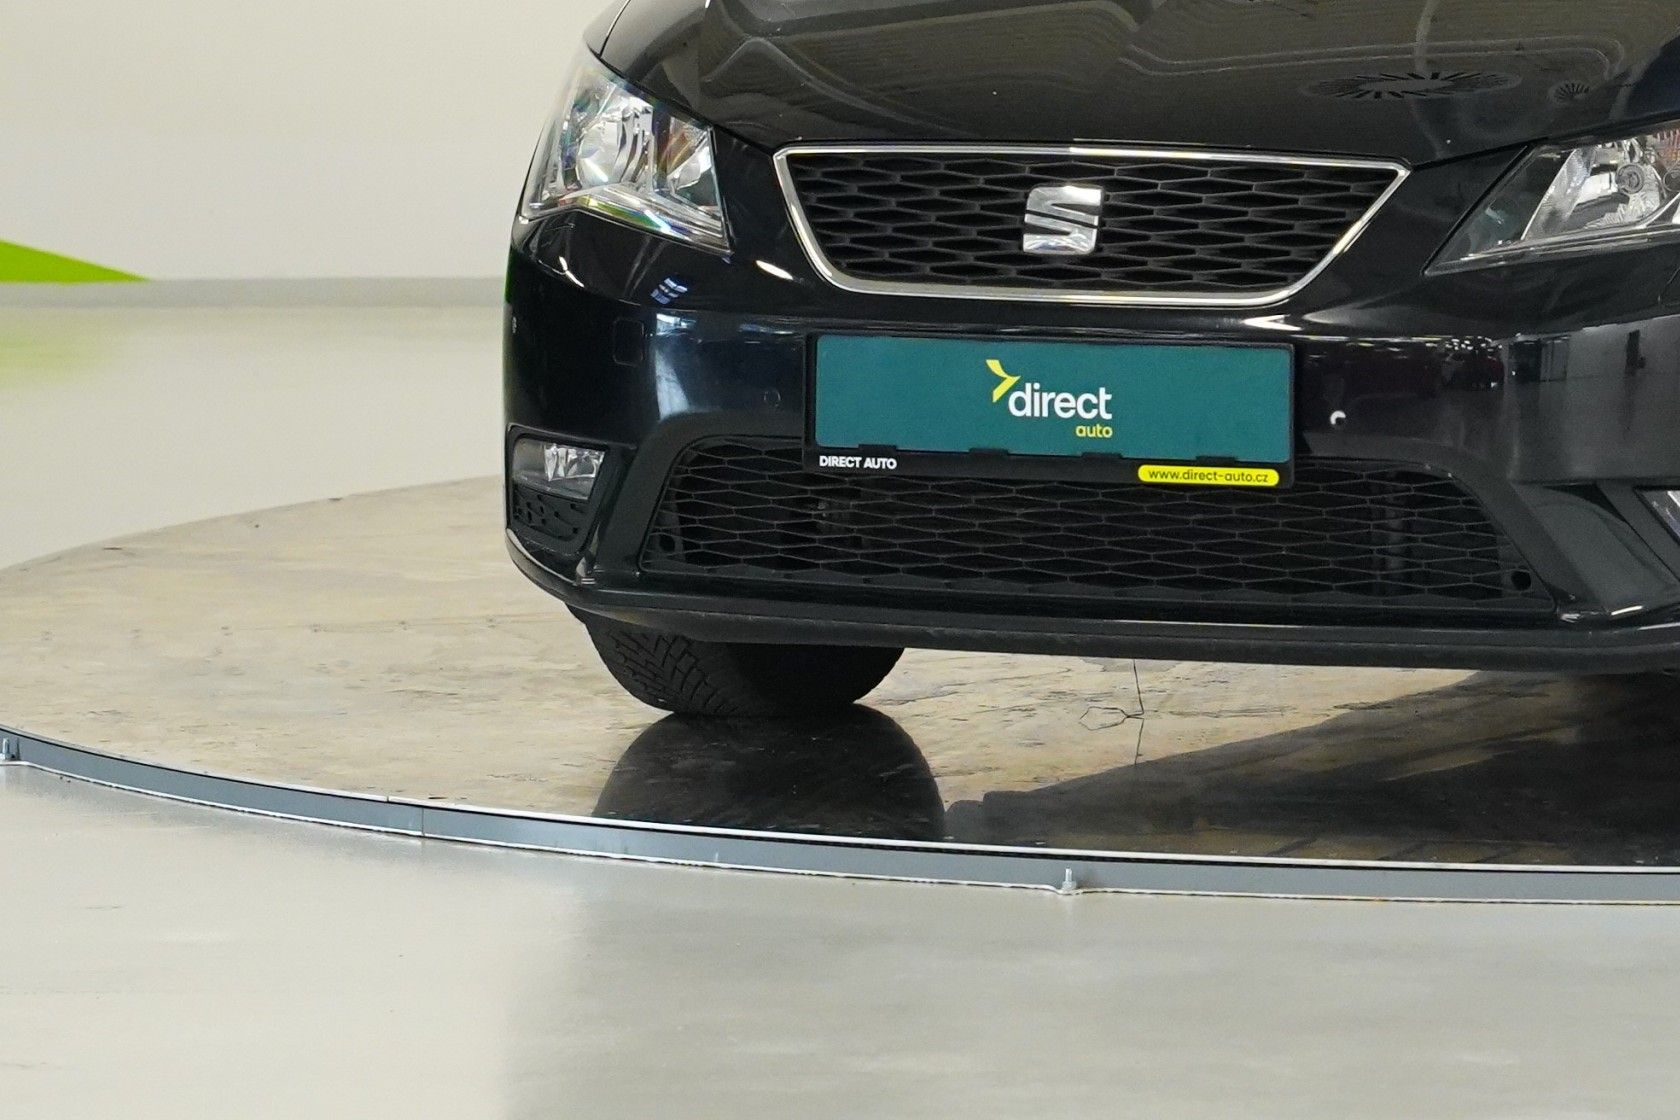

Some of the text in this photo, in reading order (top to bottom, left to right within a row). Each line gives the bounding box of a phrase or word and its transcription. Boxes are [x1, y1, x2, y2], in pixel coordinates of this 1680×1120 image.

[1008, 382, 1113, 419] direct
[1075, 423, 1113, 439] auto
[819, 455, 898, 470] DIRECT AUTO
[1148, 469, 1269, 483] www.direct-auto.cz
